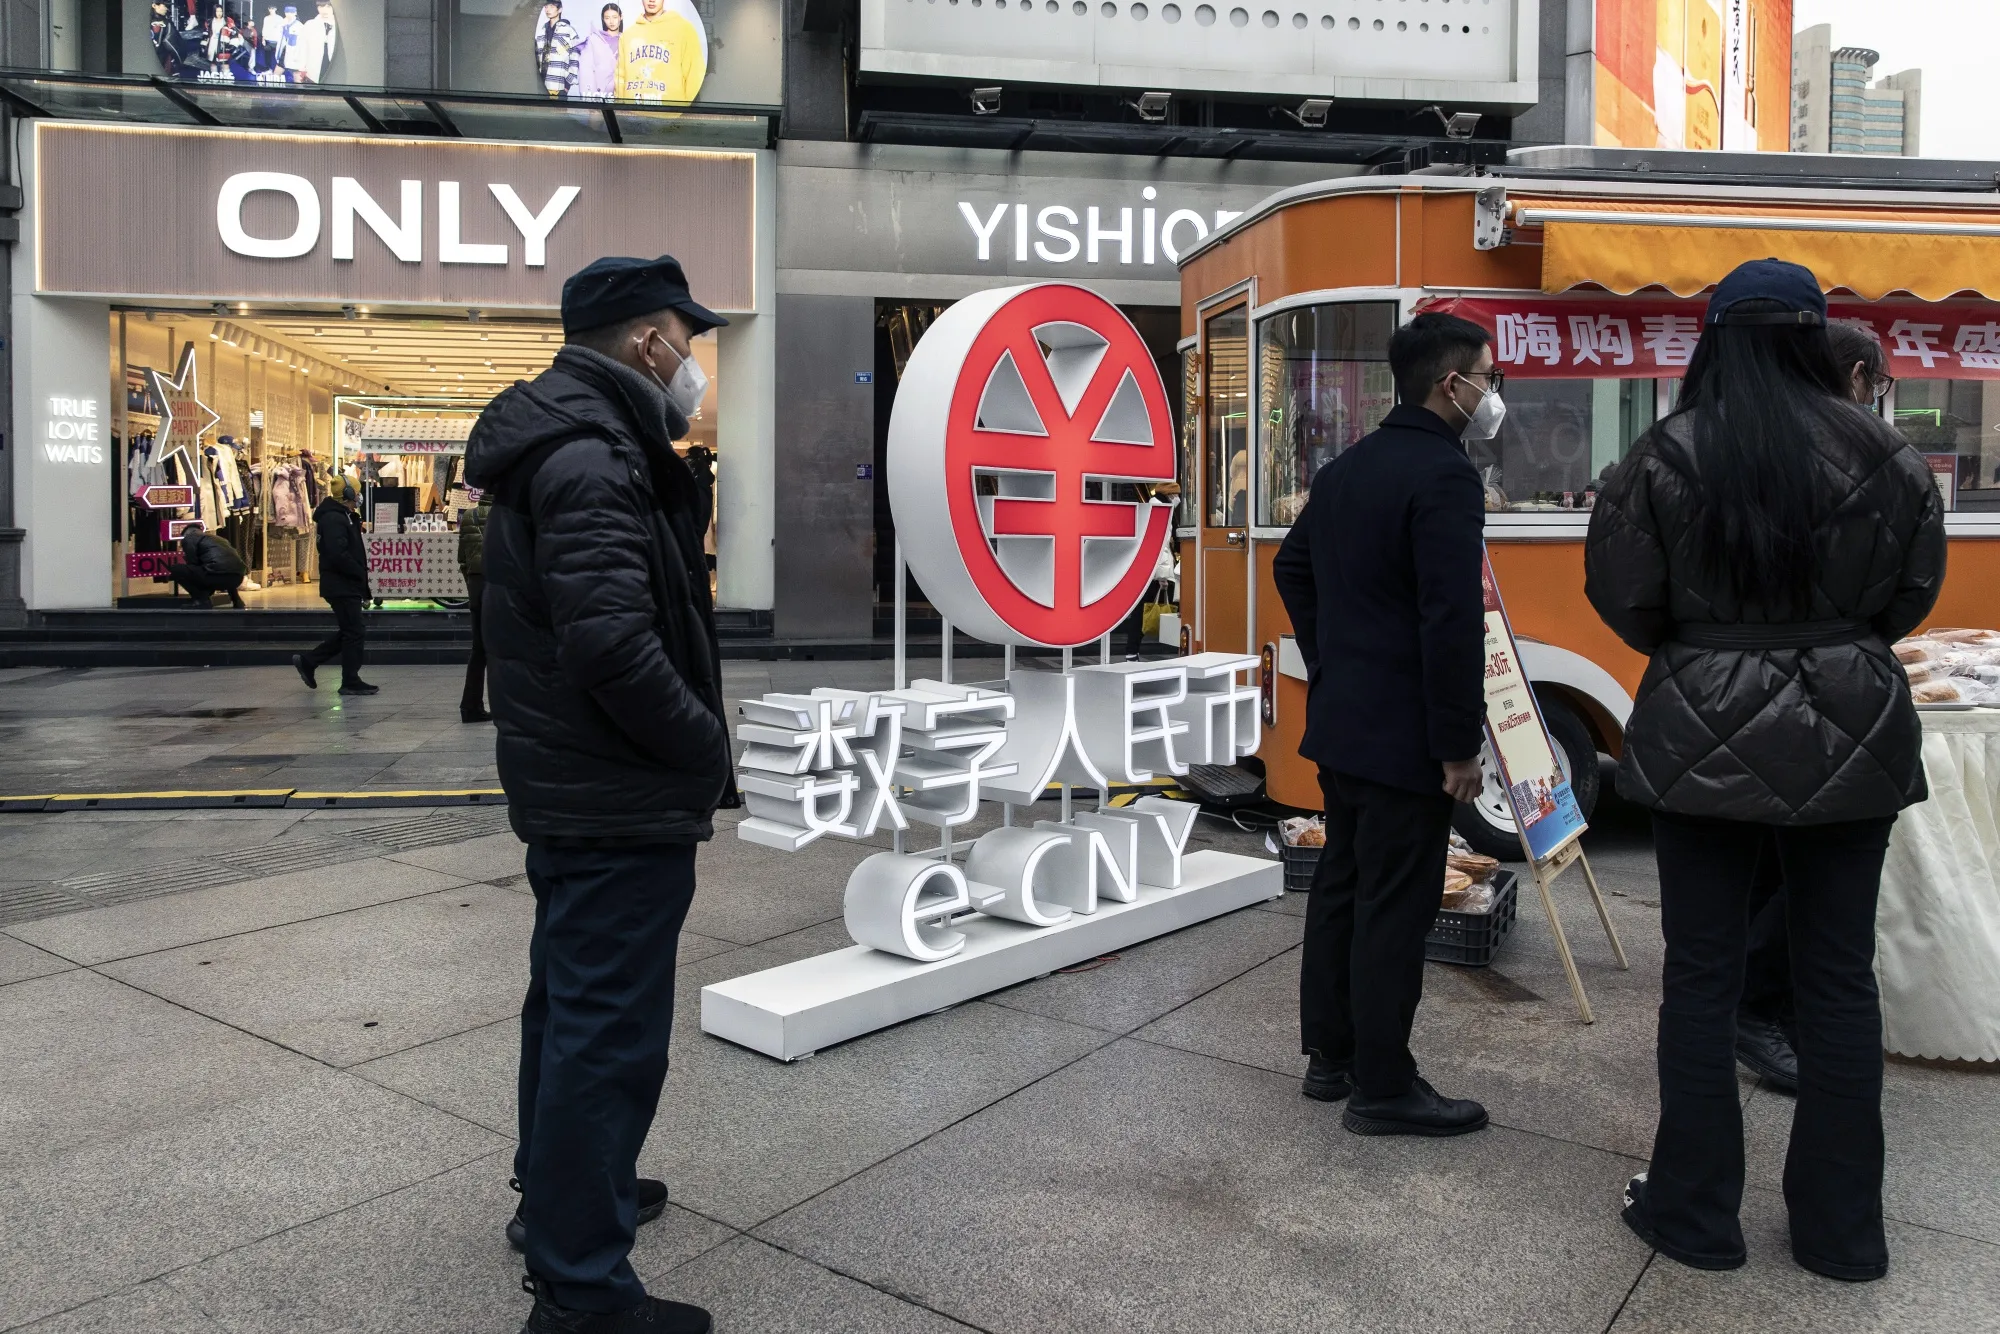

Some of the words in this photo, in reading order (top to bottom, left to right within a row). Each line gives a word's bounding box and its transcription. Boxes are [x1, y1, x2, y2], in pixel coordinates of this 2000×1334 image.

[629, 44, 670, 65] LAKERS
[217, 171, 581, 265] ONLY
[49, 397, 97, 419] TRUE
[171, 401, 198, 417] SHINY
[48, 420, 98, 441] LOVE
[171, 420, 199, 435] PARTY
[44, 443, 103, 464] WAITS
[403, 441, 449, 452] ONLY
[370, 541, 424, 556] SHINY
[369, 558, 424, 573] PARTY
[796, 654, 1262, 850] 数字人民币
[899, 801, 1201, 962] e-CNY
